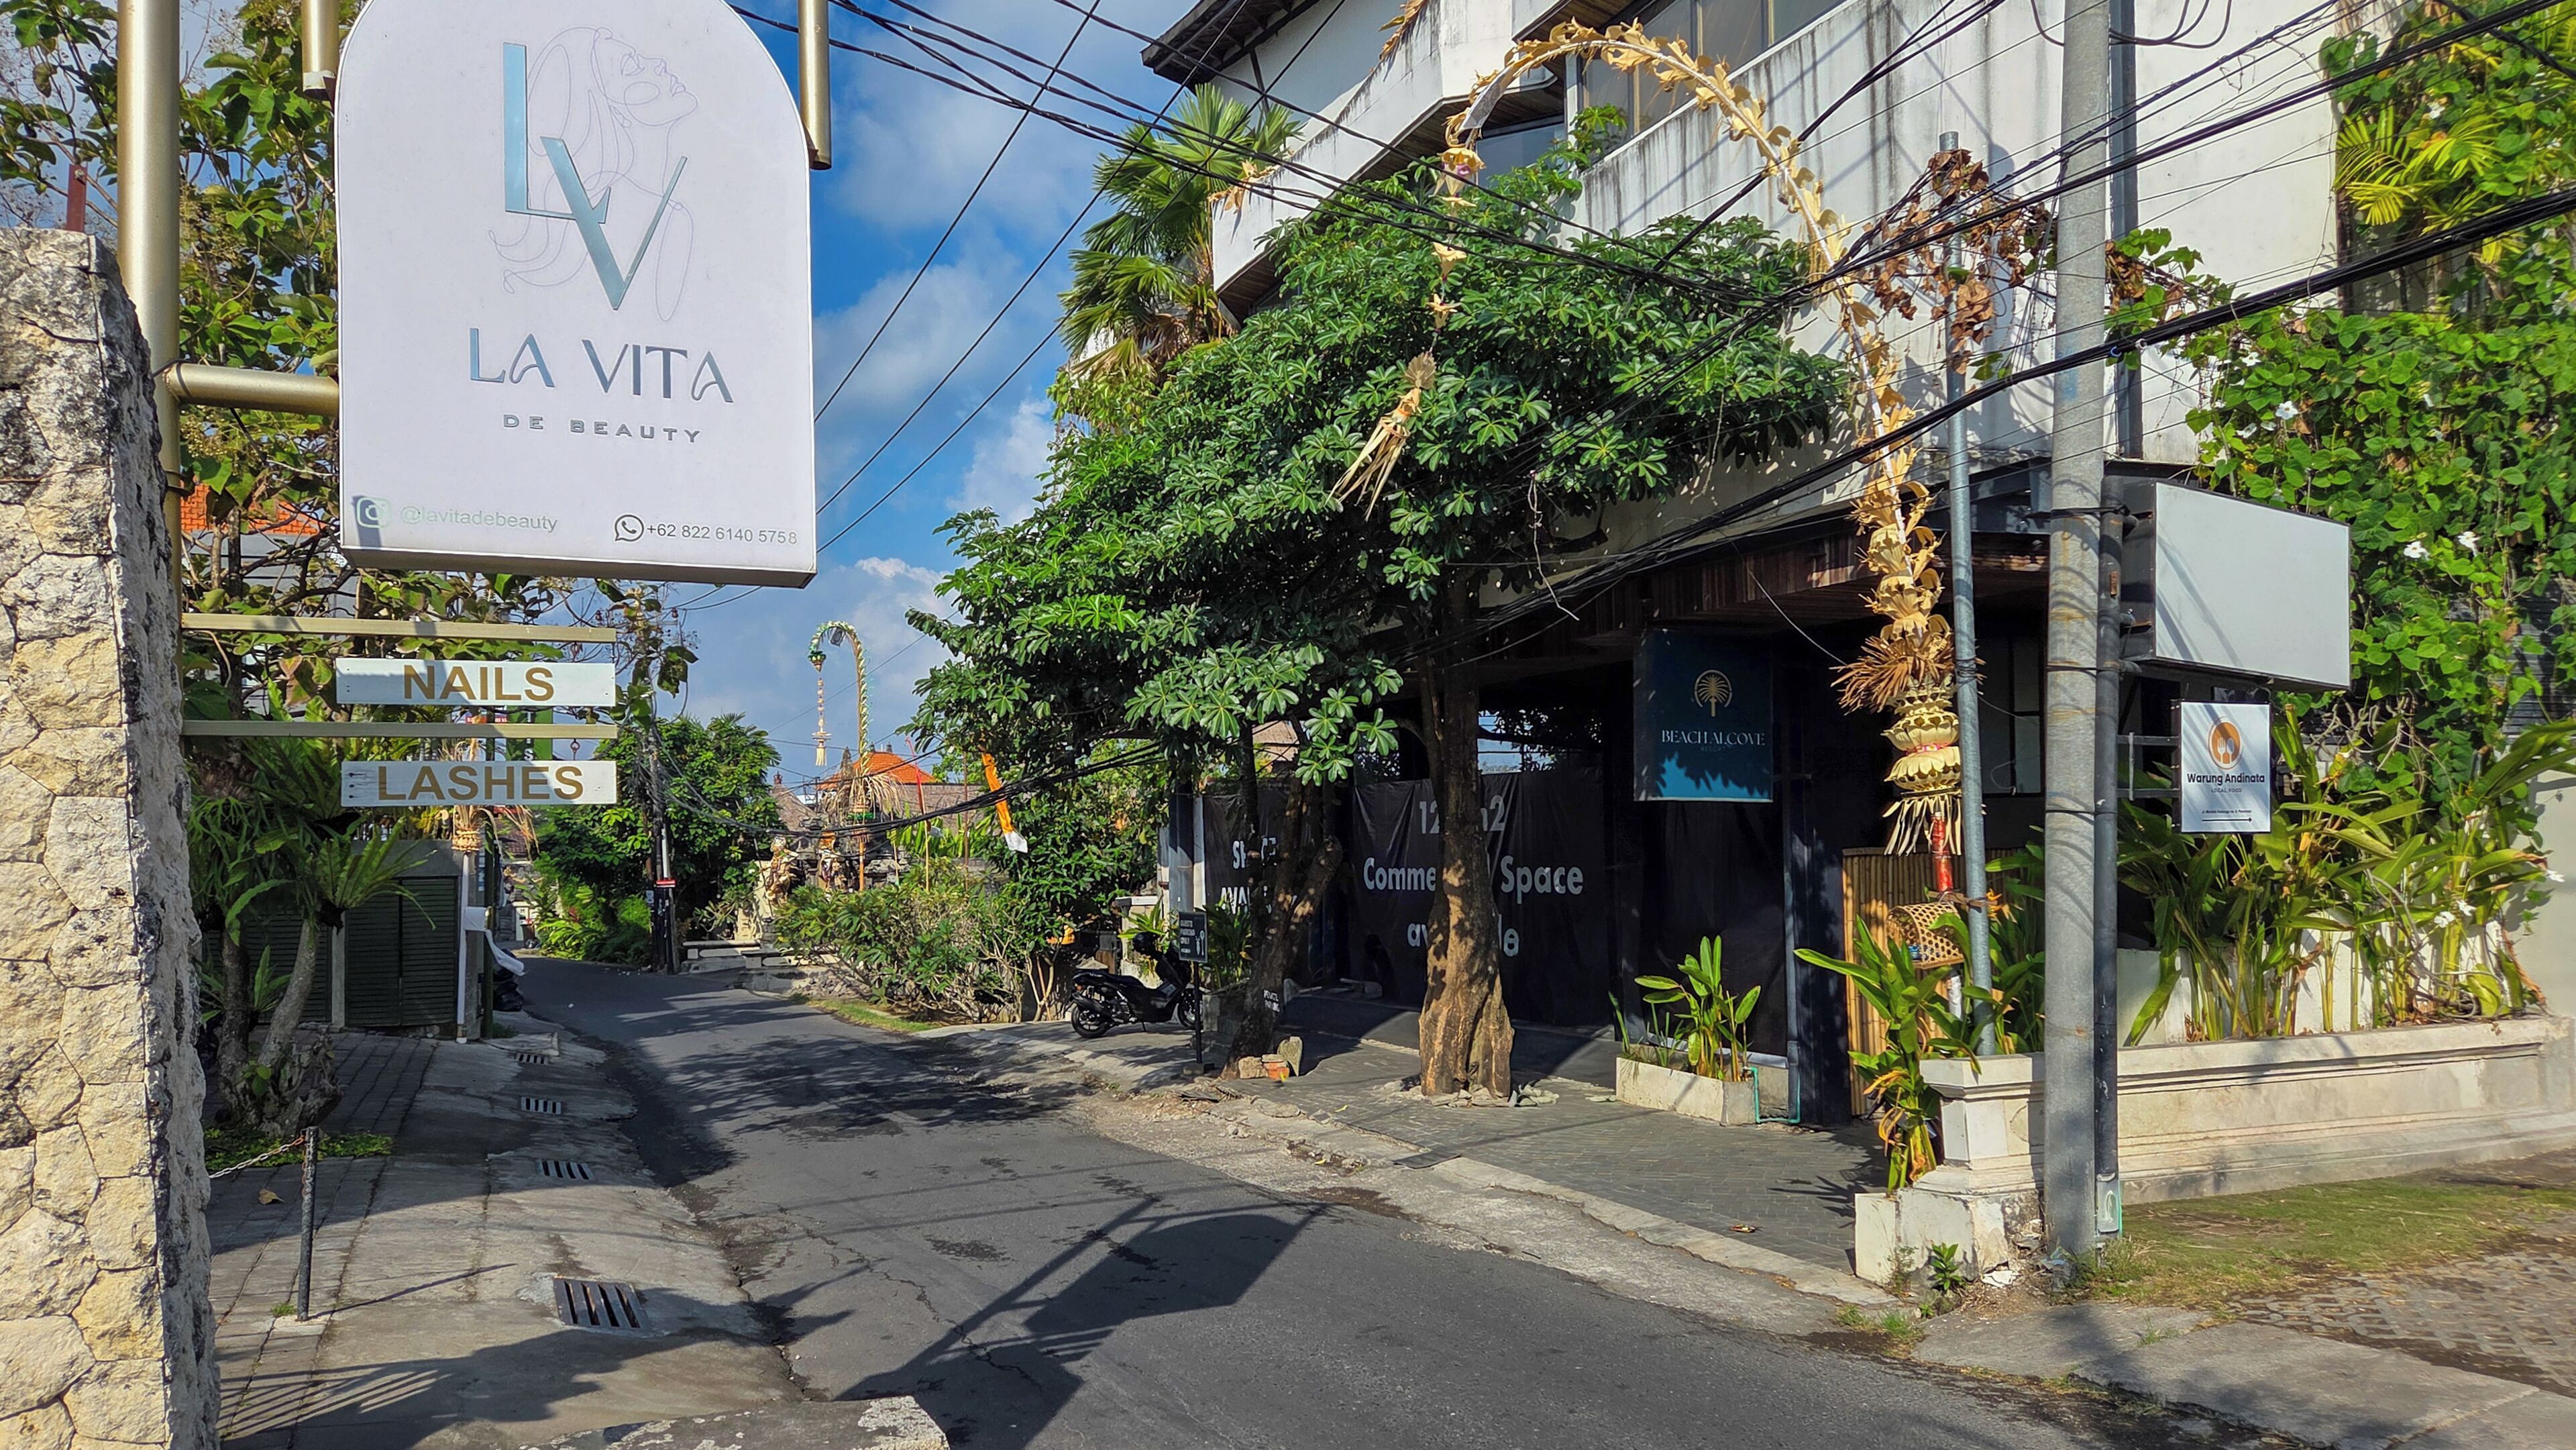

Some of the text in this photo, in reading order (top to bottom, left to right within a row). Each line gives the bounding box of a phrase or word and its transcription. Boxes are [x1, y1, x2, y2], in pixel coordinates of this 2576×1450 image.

[503, 42, 688, 311] LV
[469, 327, 734, 403] LA VITA
[502, 414, 701, 443] DE BEAUTY
[400, 505, 558, 533] @lavitadebeauty
[647, 523, 798, 545] +62 822 6140 5758
[404, 664, 555, 702] NAILS
[1662, 729, 1766, 746] BEACH ALCOVE
[378, 766, 584, 801] LASHES
[2187, 772, 2265, 786] Warung Andinata
[1363, 856, 1584, 904] Comme Space
